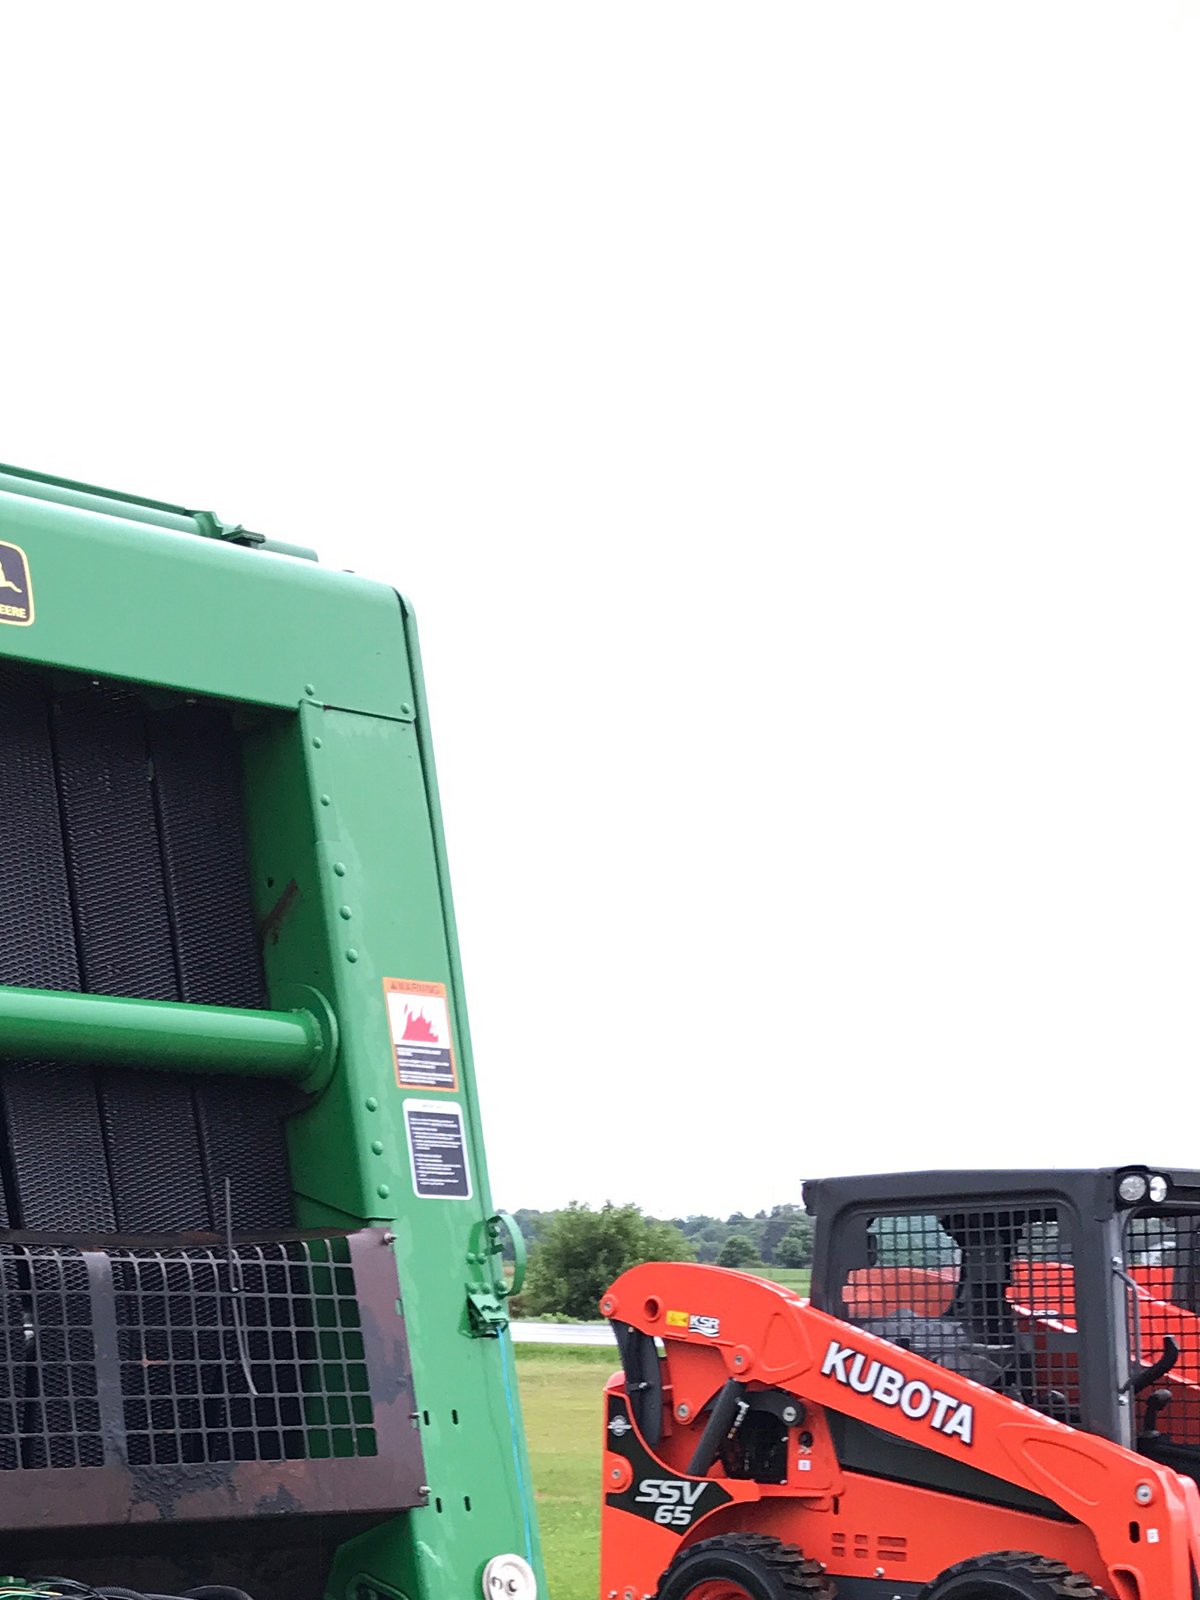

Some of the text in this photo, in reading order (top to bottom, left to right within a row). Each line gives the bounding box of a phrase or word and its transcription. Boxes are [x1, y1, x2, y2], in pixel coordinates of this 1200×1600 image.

[821, 1341, 974, 1446] KUBOTA
[634, 1479, 707, 1504] SSV
[654, 1505, 693, 1525] 65
